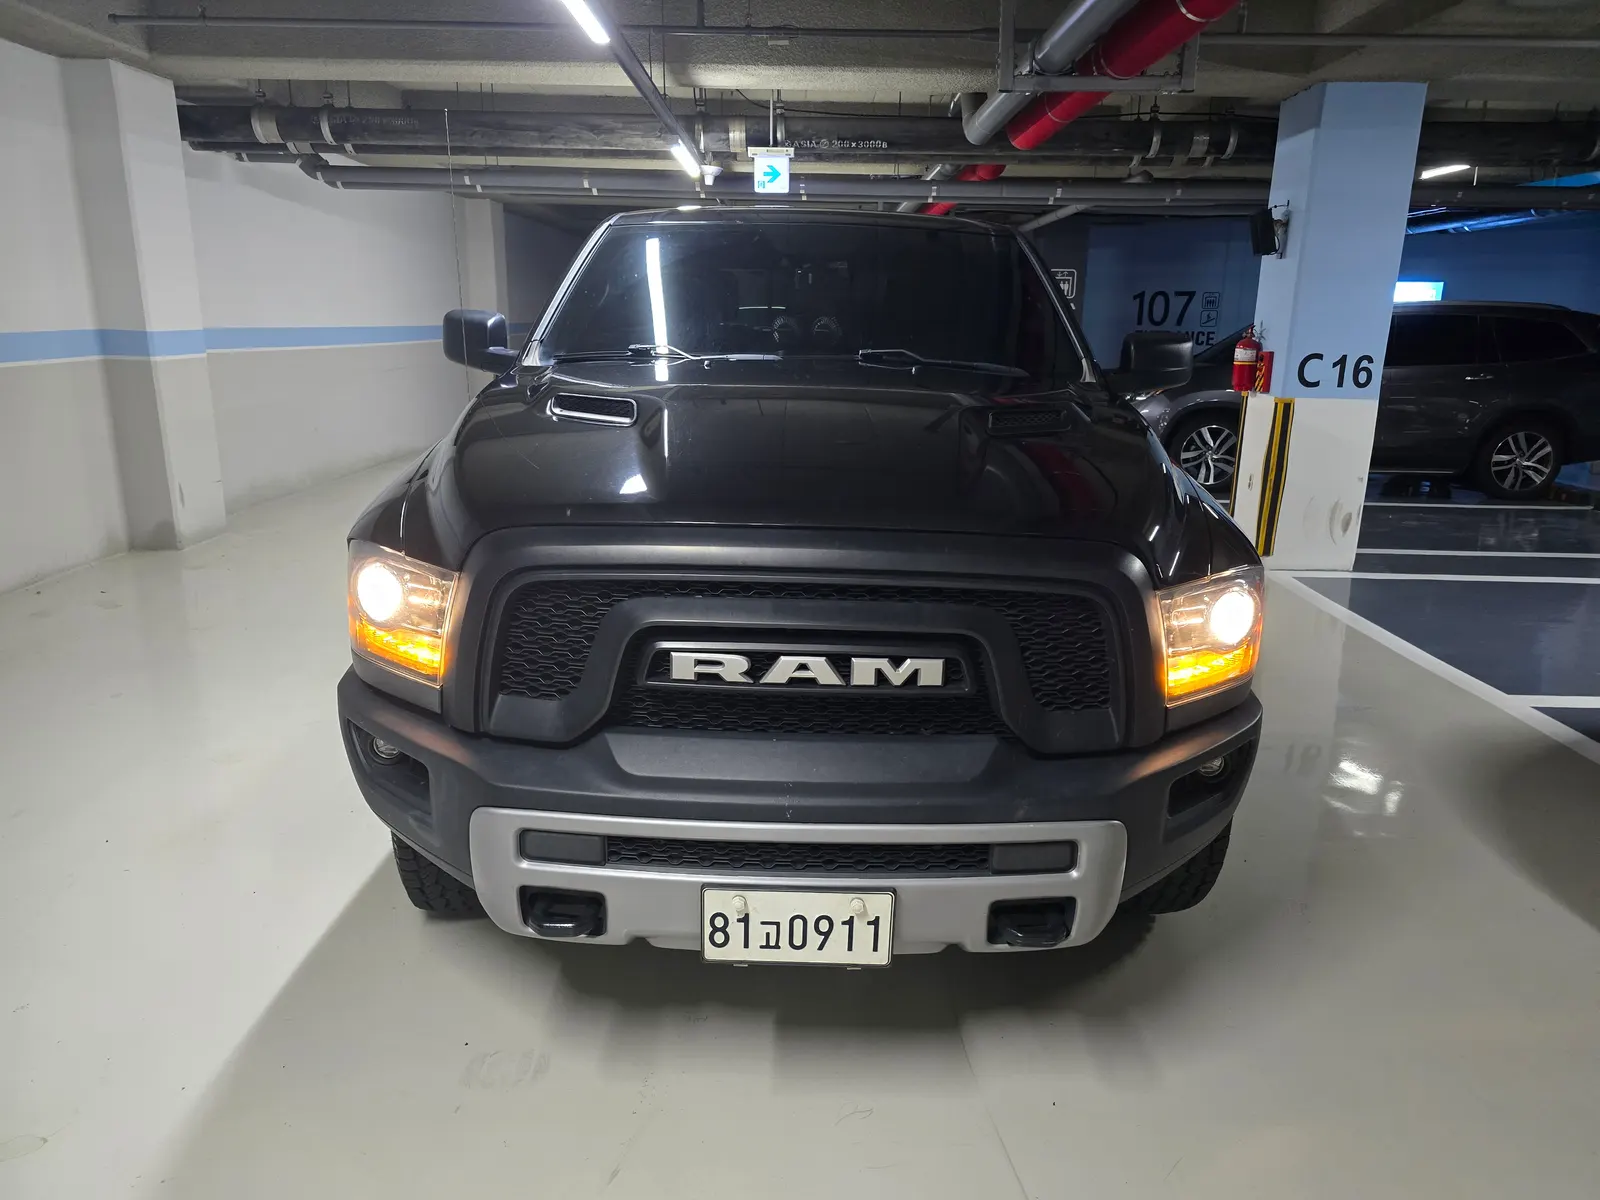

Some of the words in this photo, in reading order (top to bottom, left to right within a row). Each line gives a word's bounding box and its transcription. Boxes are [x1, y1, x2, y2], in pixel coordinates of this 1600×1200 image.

[1133, 291, 1197, 327] 107
[670, 651, 945, 686] RAM
[708, 912, 880, 952] 81고0911
